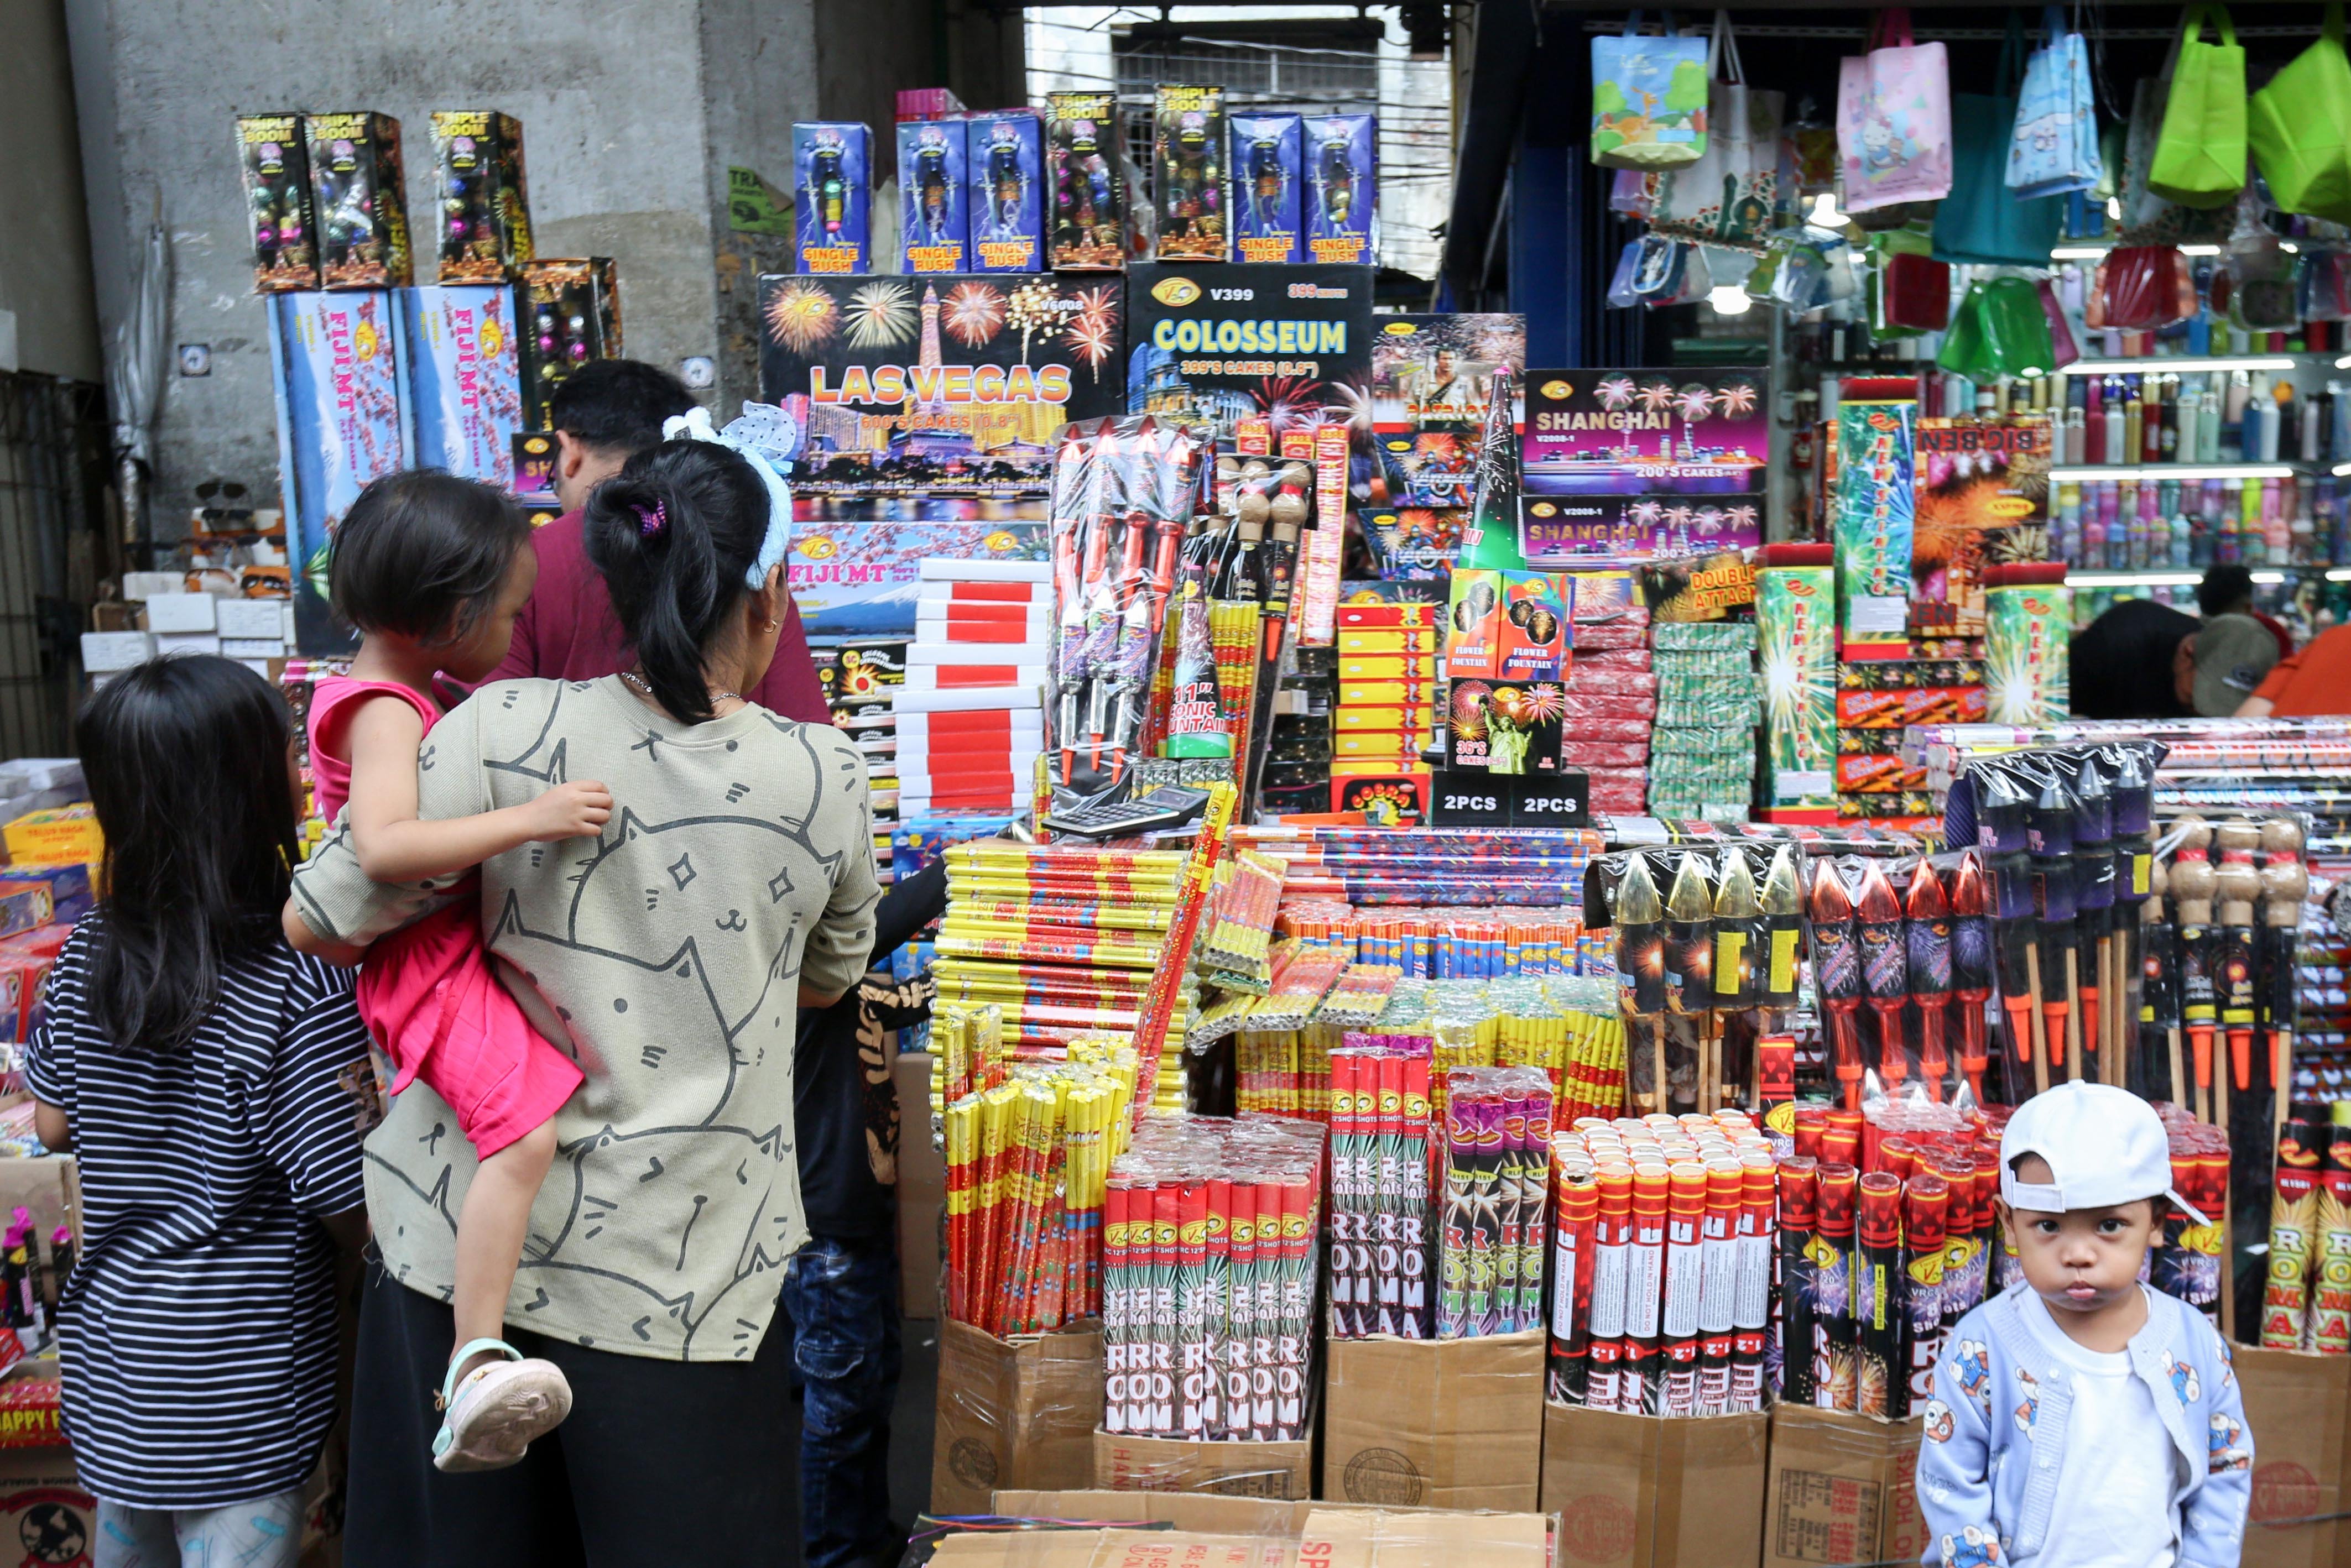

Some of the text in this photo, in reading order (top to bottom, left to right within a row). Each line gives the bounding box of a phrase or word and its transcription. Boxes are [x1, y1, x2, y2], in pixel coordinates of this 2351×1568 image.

[1162, 87, 1219, 101] TRIPLE
[1052, 95, 1111, 107] TRIPLE
[1166, 99, 1216, 112] BOOM
[432, 111, 489, 124] TRIPLE
[1057, 106, 1107, 119] BOOM
[240, 117, 295, 129] TRIPLE
[311, 114, 366, 128] TRIPLE
[244, 129, 291, 142] BOOM
[315, 127, 364, 139] BOOM
[439, 124, 486, 137] BOOM
[978, 242, 1034, 255] SINGLE
[1238, 237, 1294, 250] SINGLE
[1310, 238, 1365, 252] SINGLE
[802, 248, 858, 261] SINGLE
[907, 247, 962, 260] SINGLE
[1245, 250, 1287, 262] RUSH
[1317, 251, 1359, 263] RUSH
[810, 261, 853, 273] RUSH
[914, 260, 956, 272] RUSH
[985, 255, 1028, 267] RUSH
[1211, 289, 1253, 301] V399
[1289, 285, 1316, 297] 399
[1154, 319, 1347, 353] COLOSSEUM
[330, 311, 355, 413] FIJI MT
[455, 309, 481, 411] FIJI MT
[1181, 361, 1221, 375] 399'S
[1225, 362, 1275, 375] CAKES
[810, 364, 1072, 405] LAS VEGAS
[861, 416, 906, 428] 600'S
[910, 416, 970, 428] CAKES
[1536, 412, 1670, 431] SHANGHAI
[1921, 431, 2034, 451] BIG BEN
[1635, 466, 1724, 478] 200'S CAKES
[1529, 525, 1649, 540] SHANGHAI
[1651, 548, 1691, 558] 200'S
[788, 565, 886, 582] FIJI MT
[1690, 564, 1756, 590] DOUBLE
[1456, 646, 1483, 655] FLOWER
[1513, 647, 1548, 657] FLOWER
[1452, 657, 1487, 667] FOUNTAIN
[1508, 660, 1552, 669] FOUNTAIN
[1457, 741, 1487, 755] 36'S
[1445, 796, 1497, 811] 2PCS
[1524, 798, 1577, 813] 2PCS
[1644, 1321, 1650, 1331] DO
[1895, 1450, 1917, 1524] HOOKS
